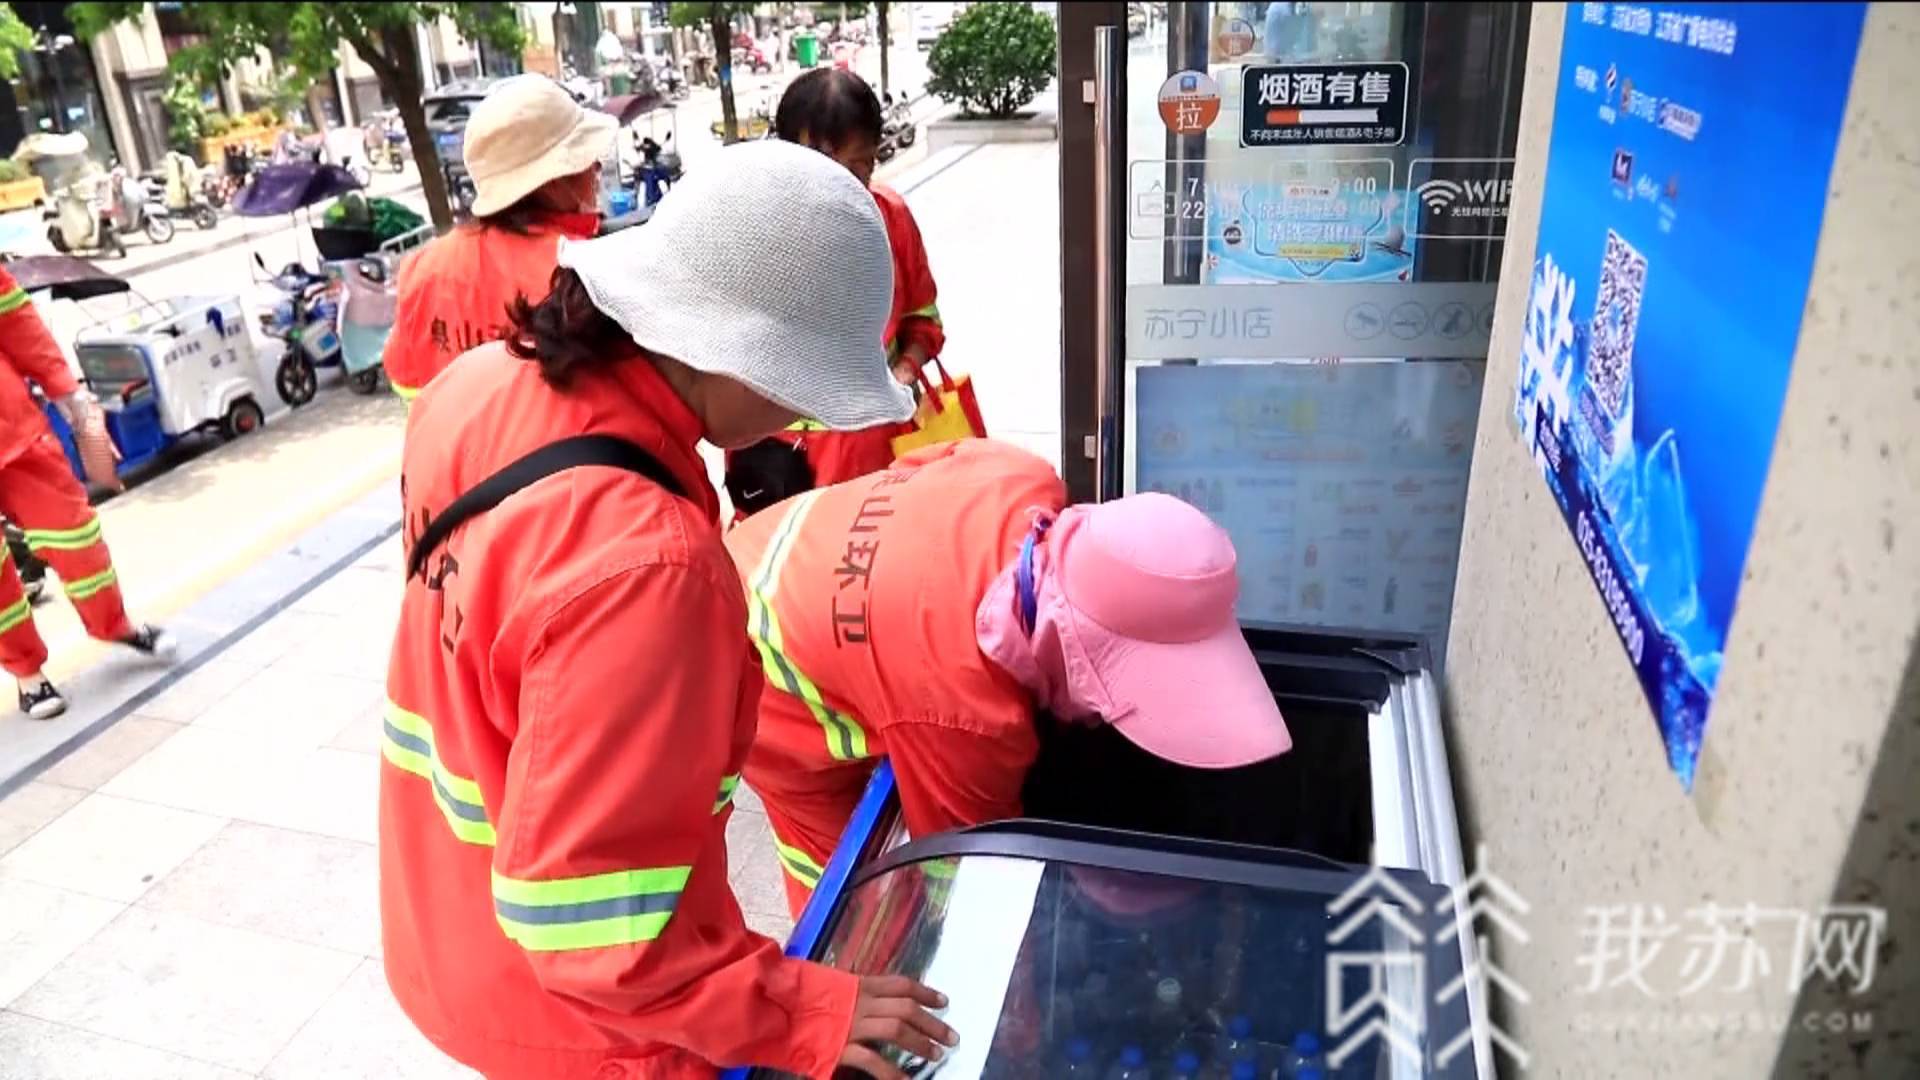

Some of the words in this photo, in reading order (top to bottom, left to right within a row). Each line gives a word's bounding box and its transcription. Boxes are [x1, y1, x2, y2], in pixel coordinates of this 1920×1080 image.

[1257, 71, 1391, 105] 烟酒有售
[1175, 101, 1204, 131] 拉
[1143, 306, 1273, 339] 苏宁小店
